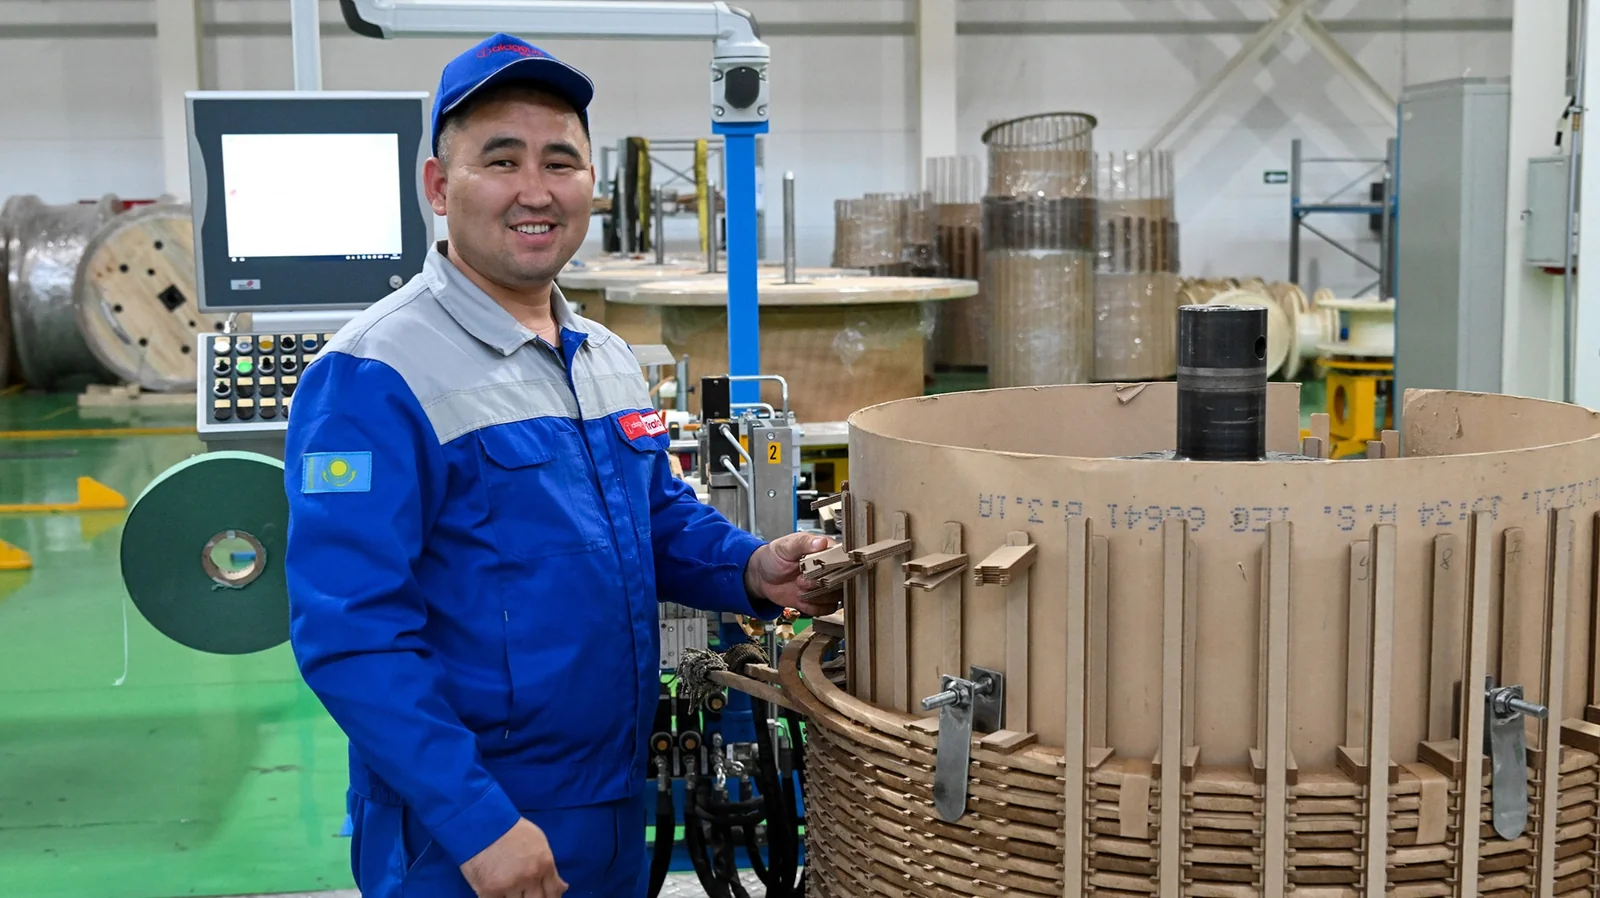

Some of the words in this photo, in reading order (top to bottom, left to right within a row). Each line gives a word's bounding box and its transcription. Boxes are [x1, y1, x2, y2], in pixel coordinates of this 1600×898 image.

[769, 444, 777, 460] 2
[1230, 507, 1289, 533] IEC
[1440, 548, 1453, 570] 8
